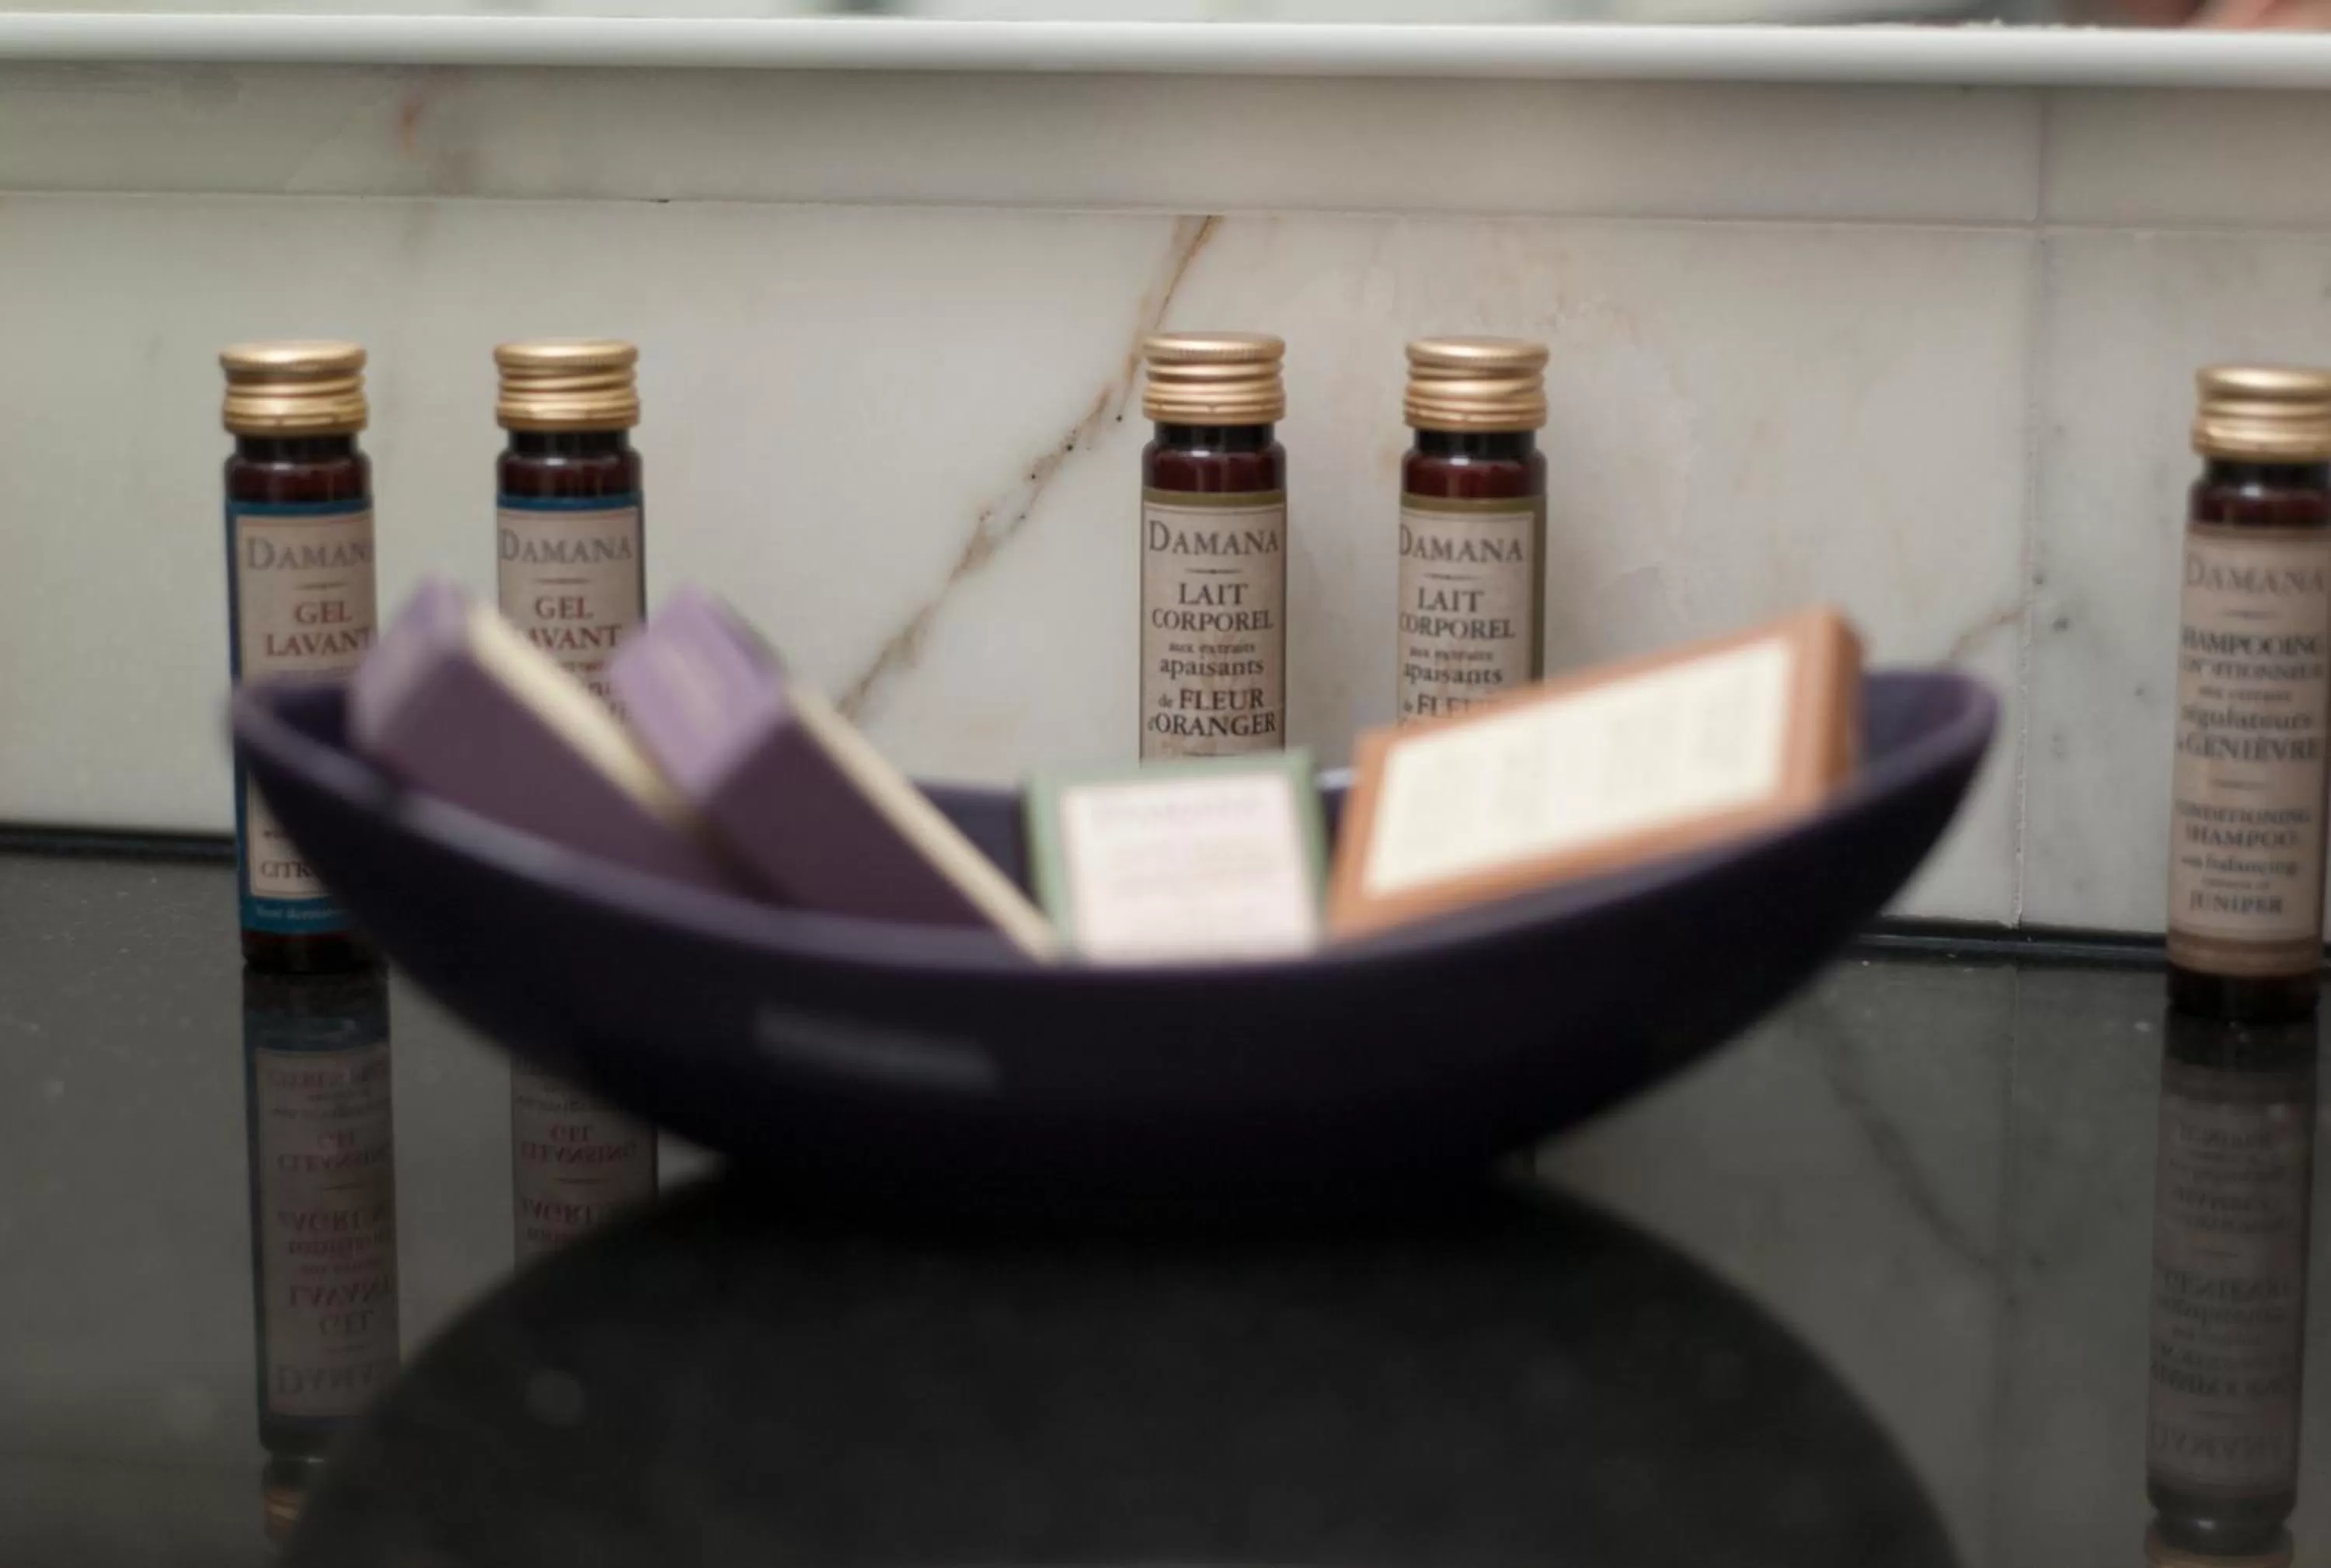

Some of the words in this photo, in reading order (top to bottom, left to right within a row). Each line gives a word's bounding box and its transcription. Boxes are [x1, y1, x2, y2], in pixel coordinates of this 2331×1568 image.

[500, 528, 633, 564] DAMANA
[1148, 519, 1280, 556] DAMANA
[1399, 521, 1525, 563] DAMANA
[1178, 582, 1249, 606] LAIT
[1417, 587, 1486, 613] LAIT
[294, 599, 353, 623] GEL
[534, 595, 595, 620] GEL
[1152, 608, 1275, 632] CORPOREL
[528, 623, 622, 651] AVANT
[1159, 658, 1265, 681] apaisants
[1179, 687, 1265, 711] FLEUR
